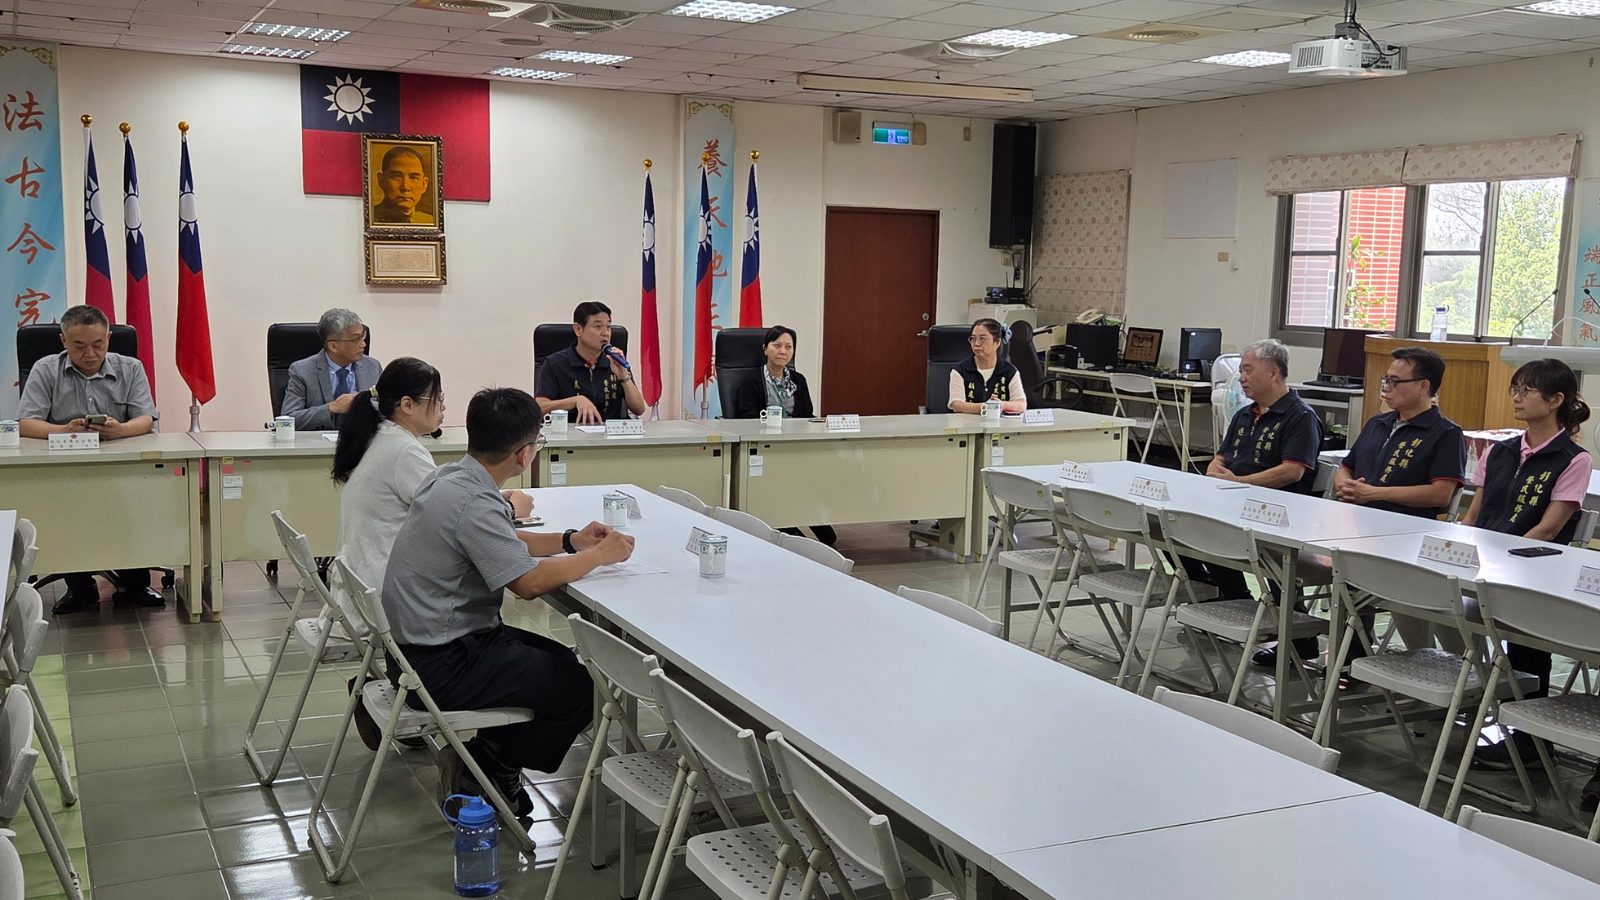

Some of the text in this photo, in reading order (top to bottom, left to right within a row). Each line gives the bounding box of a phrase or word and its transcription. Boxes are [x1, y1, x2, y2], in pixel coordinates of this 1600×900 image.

[3, 90, 57, 387] 法古今完
[1578, 245, 1600, 342] 端正風氣
[1399, 438, 1423, 469] 彰化縣
[1529, 470, 1552, 507] 彰化縣
